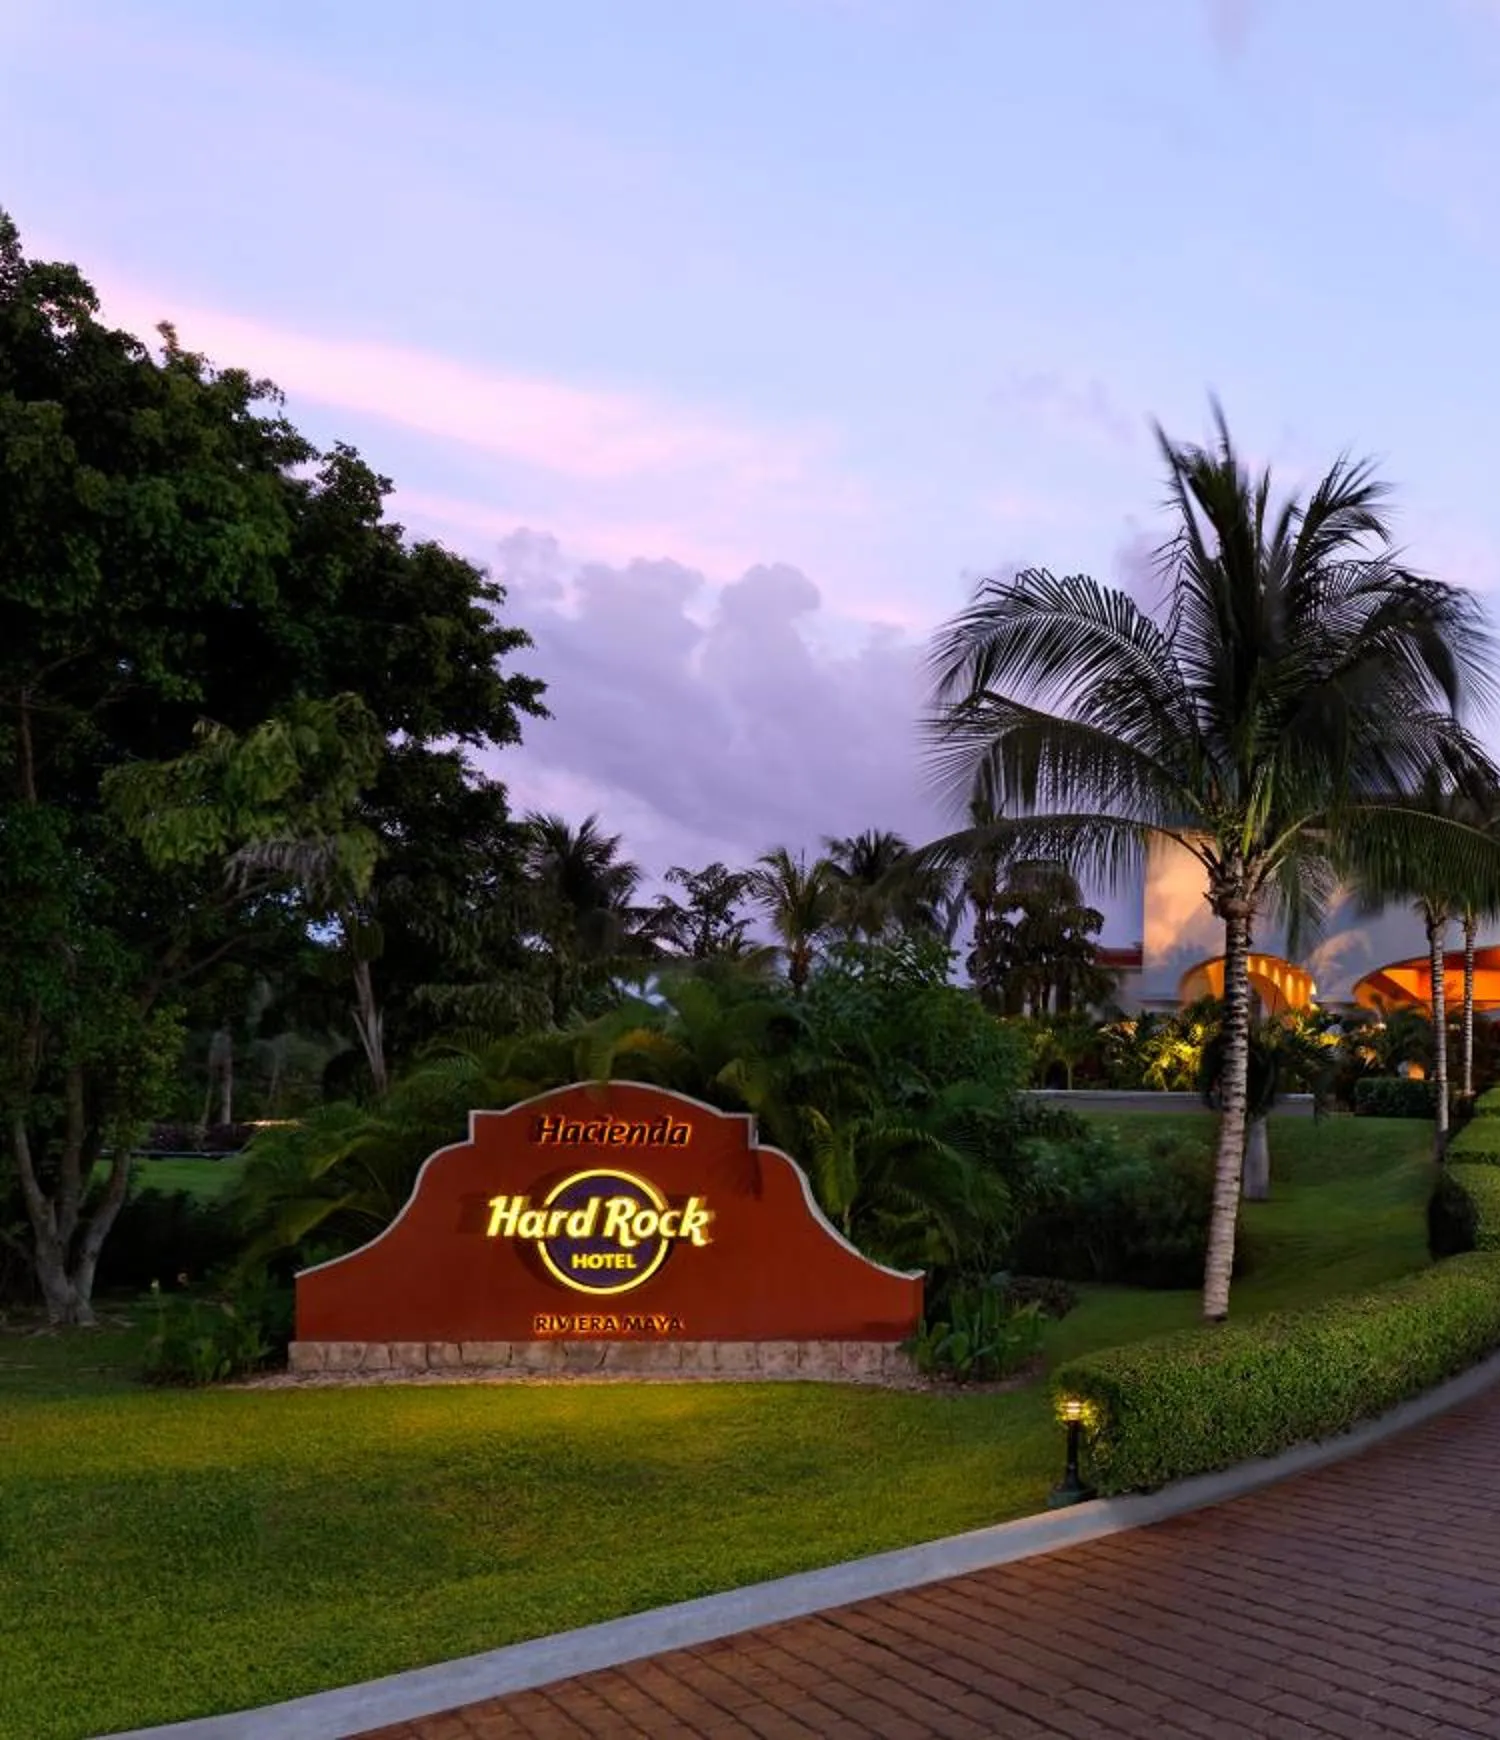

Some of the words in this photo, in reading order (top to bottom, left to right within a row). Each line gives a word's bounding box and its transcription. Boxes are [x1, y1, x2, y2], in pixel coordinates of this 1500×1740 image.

[537, 1114, 692, 1147] Hacienda
[486, 1195, 600, 1239] Hard
[602, 1197, 716, 1248] Rock
[571, 1253, 637, 1270] HOTEL
[535, 1314, 618, 1333] RIVIERA
[622, 1314, 685, 1333] MAYA
